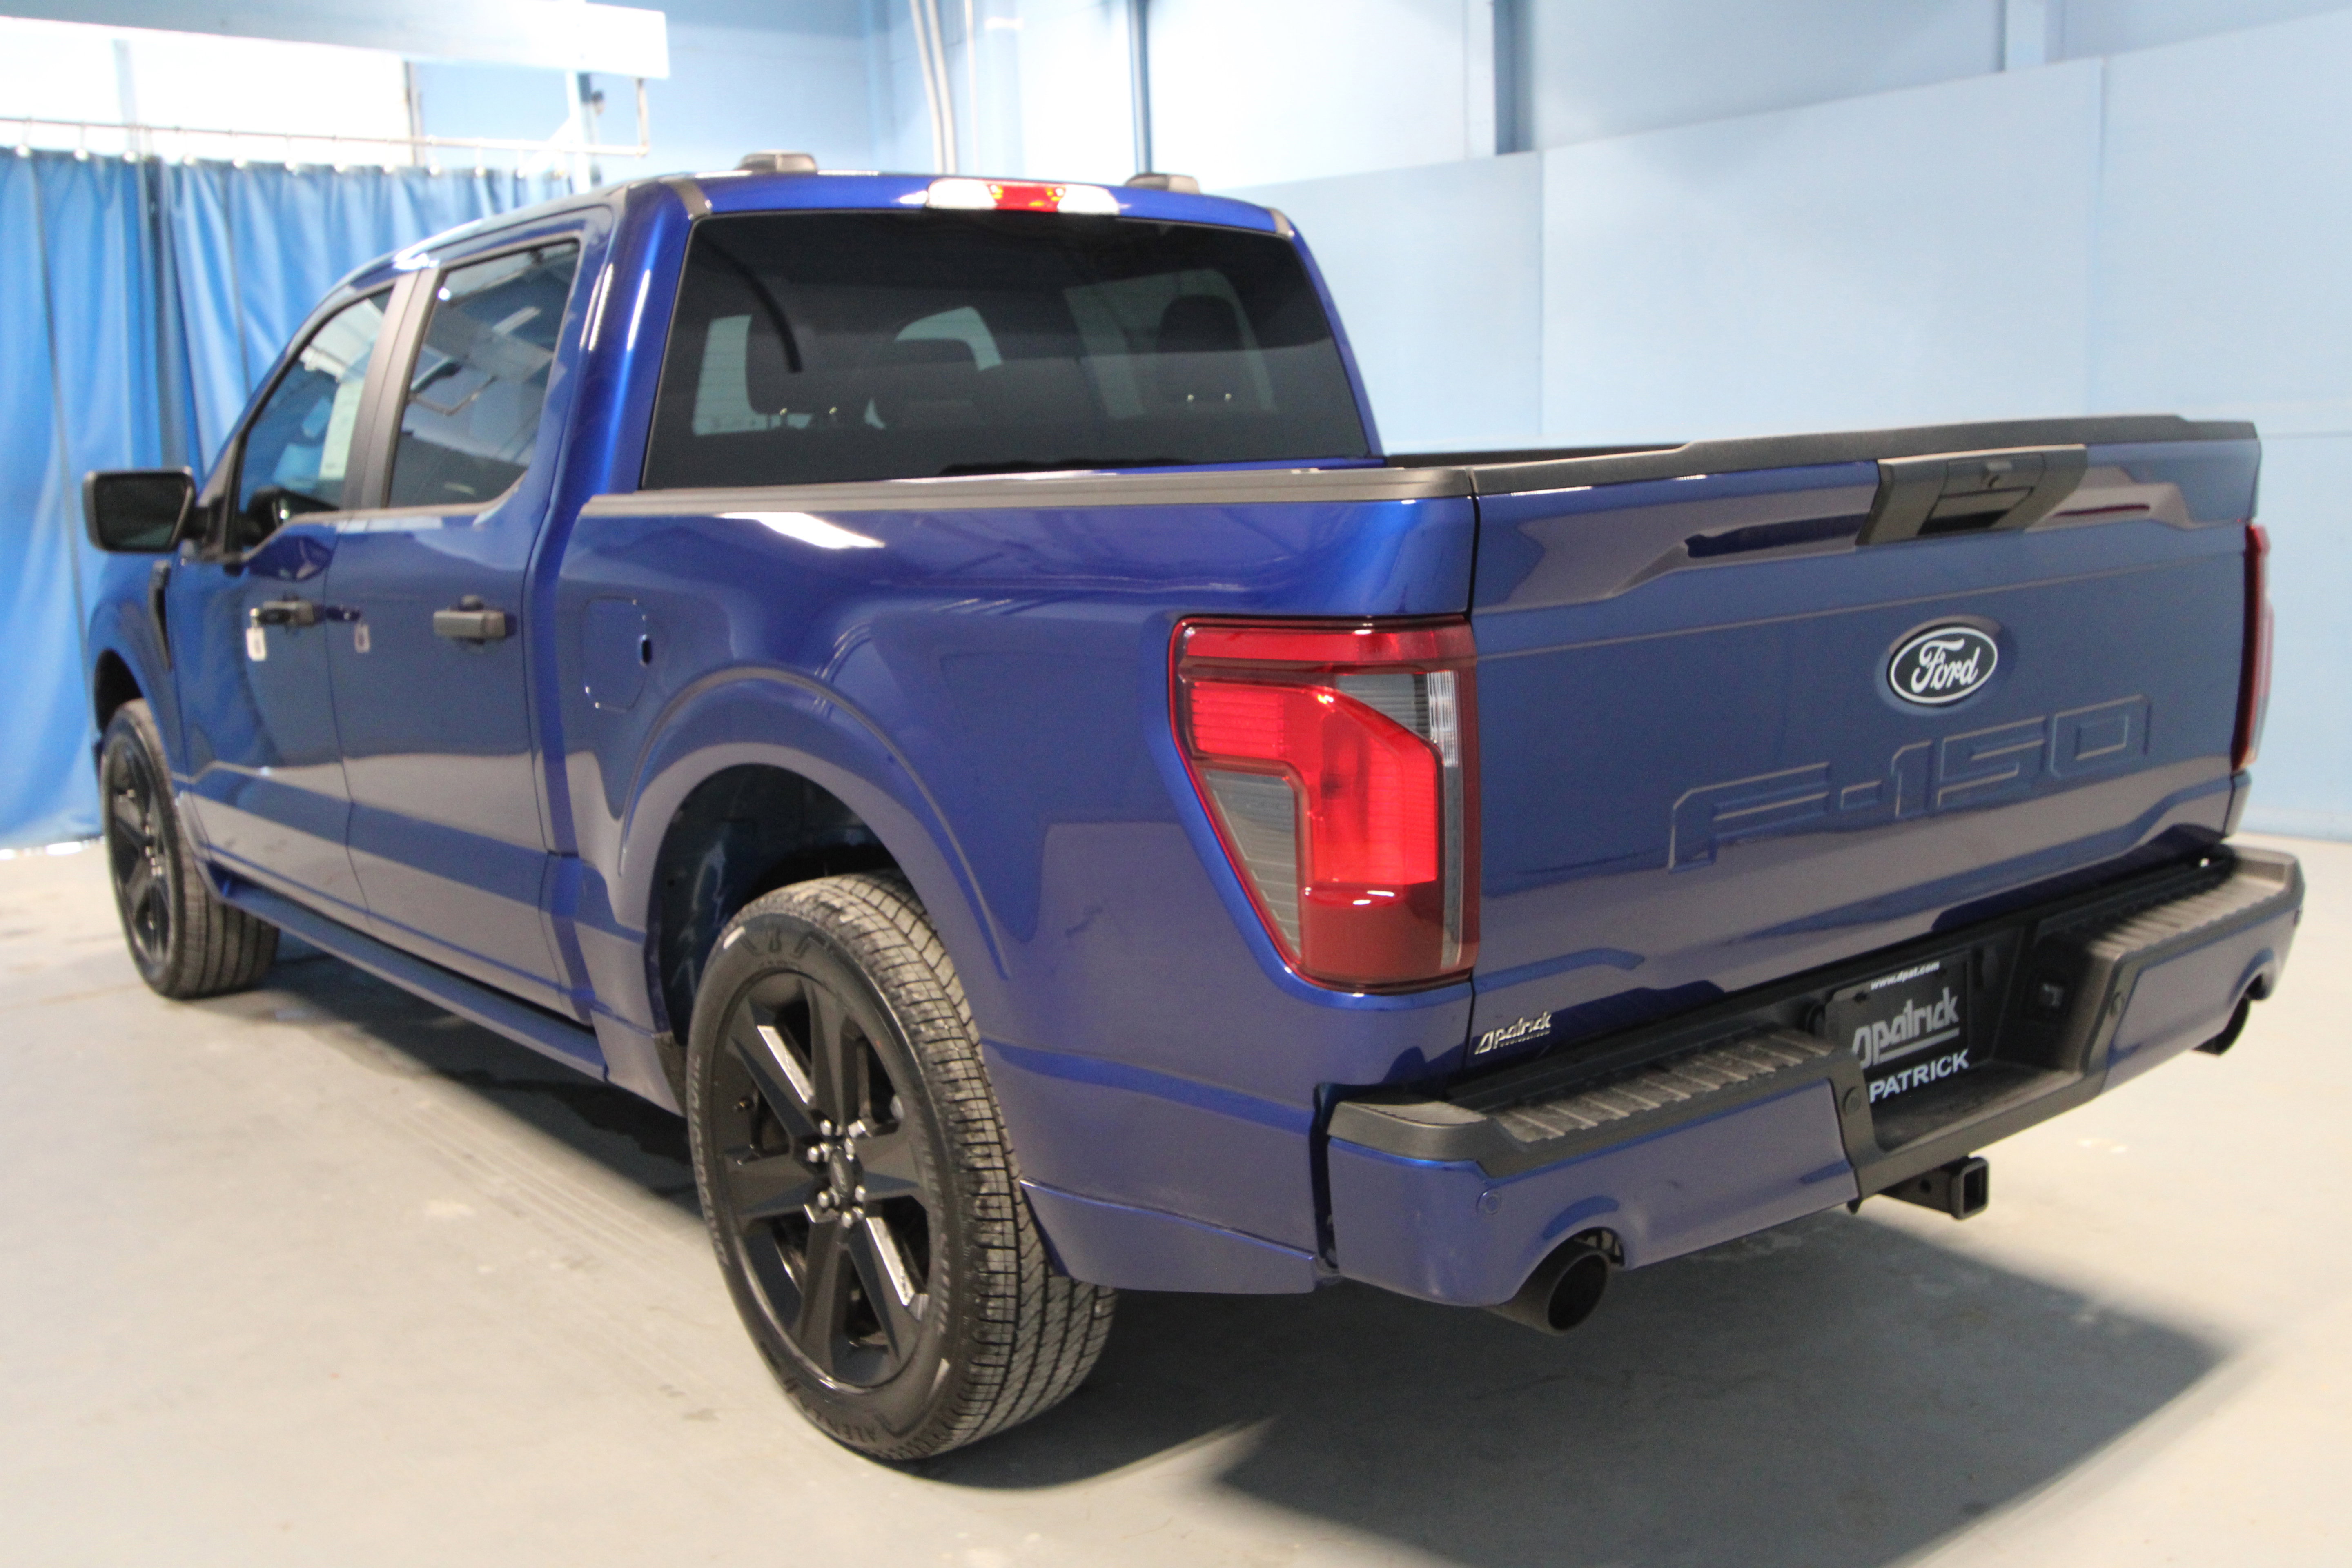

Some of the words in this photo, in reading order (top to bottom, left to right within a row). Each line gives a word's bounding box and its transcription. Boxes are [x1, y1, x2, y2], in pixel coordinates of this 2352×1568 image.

[1911, 638, 1980, 693] Ford
[1668, 694, 2151, 874] F-150
[1869, 1048, 1969, 1103] PATRICK
